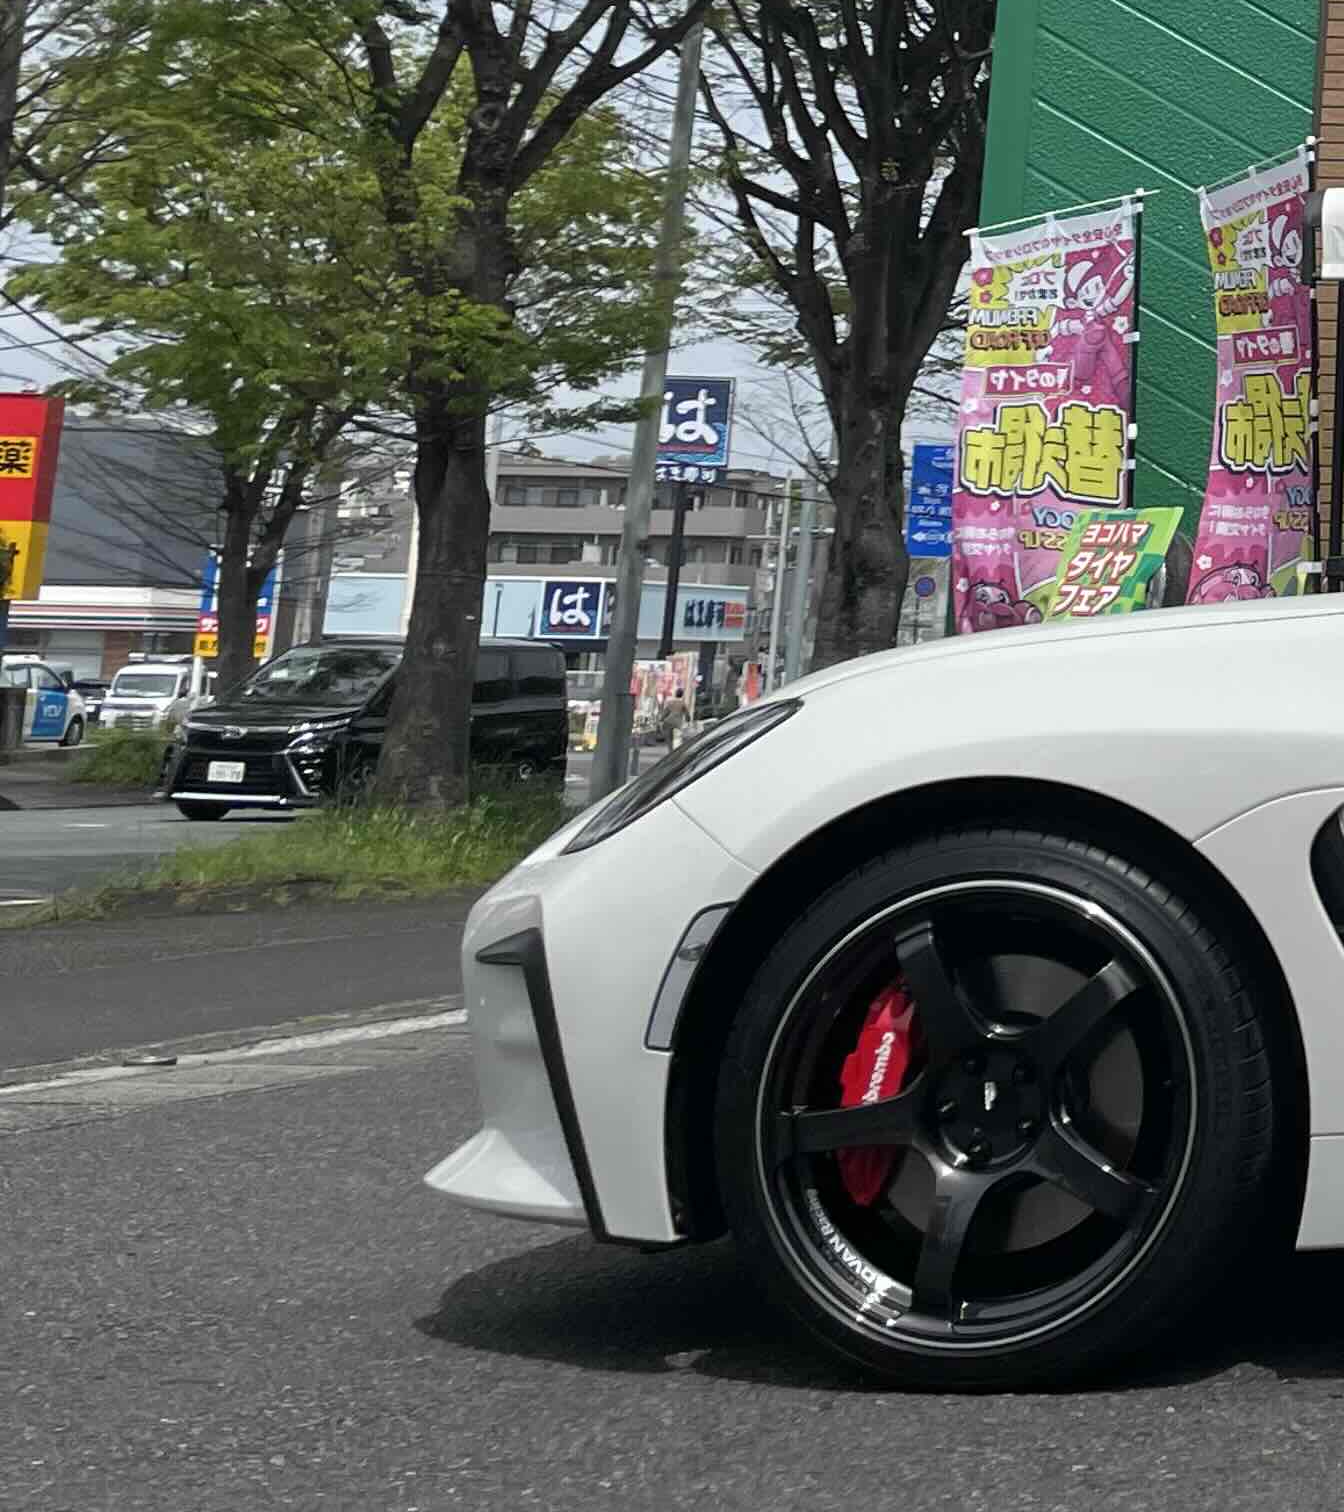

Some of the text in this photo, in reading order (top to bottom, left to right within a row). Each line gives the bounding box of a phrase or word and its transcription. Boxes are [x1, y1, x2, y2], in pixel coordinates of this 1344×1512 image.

[0, 440, 32, 475] 薬
[1081, 522, 1149, 545] ヨコハマ
[1068, 551, 1137, 583] タイヤ
[549, 587, 592, 627] は
[1054, 584, 1122, 615] フェア
[862, 1031, 896, 1106] brembo
